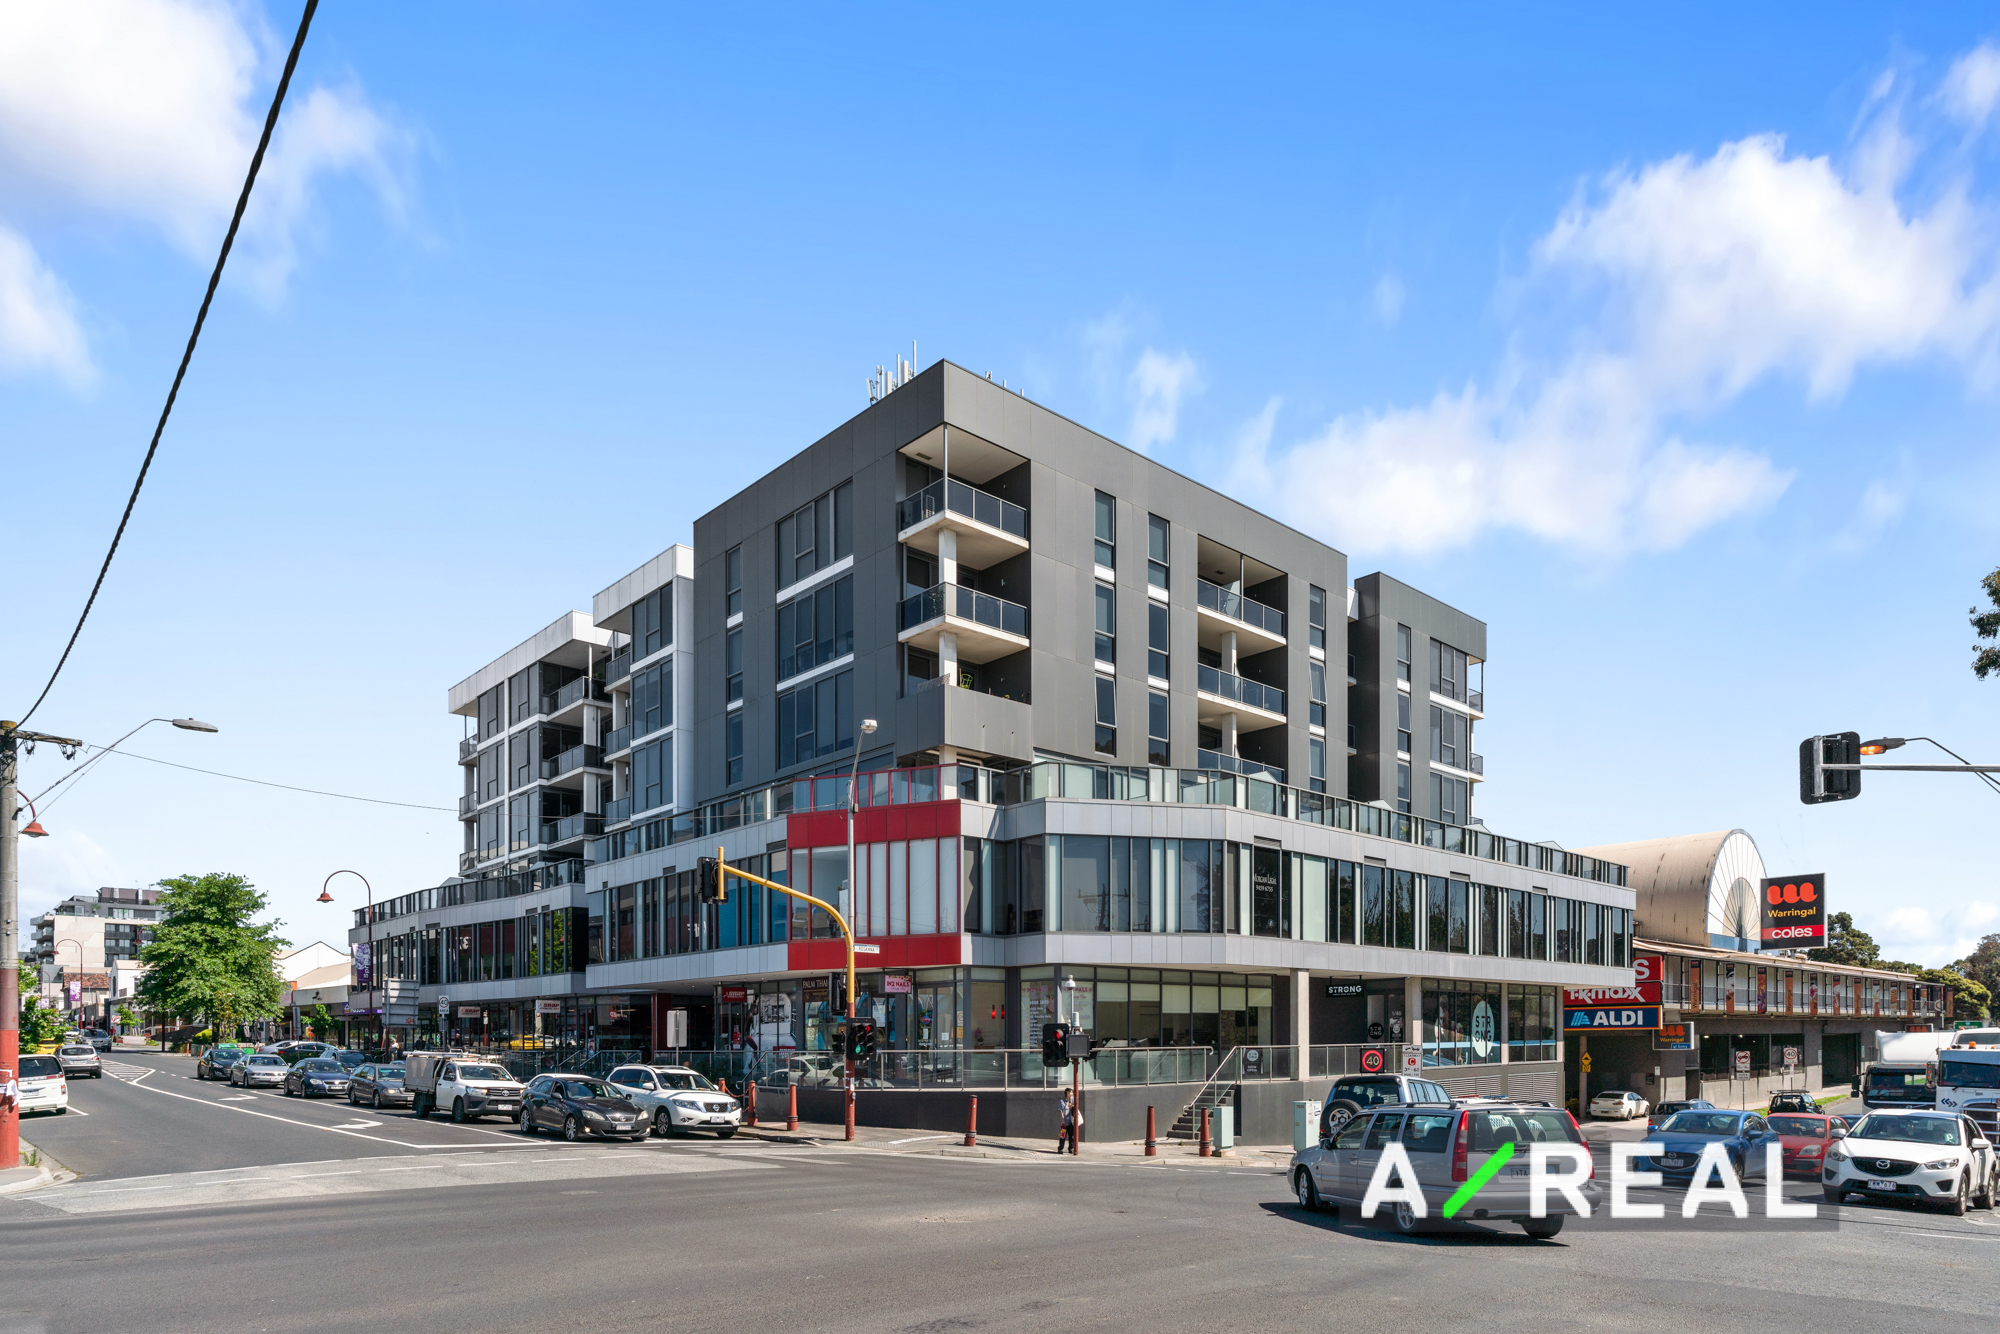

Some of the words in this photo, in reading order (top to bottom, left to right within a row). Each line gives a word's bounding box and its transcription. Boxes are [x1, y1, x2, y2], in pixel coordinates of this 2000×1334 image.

[1768, 906, 1816, 918] Warringal
[1771, 926, 1813, 939] coles
[1328, 985, 1362, 994] STRONG
[1592, 1010, 1644, 1026] ALDI
[1366, 1056, 1379, 1065] 40
